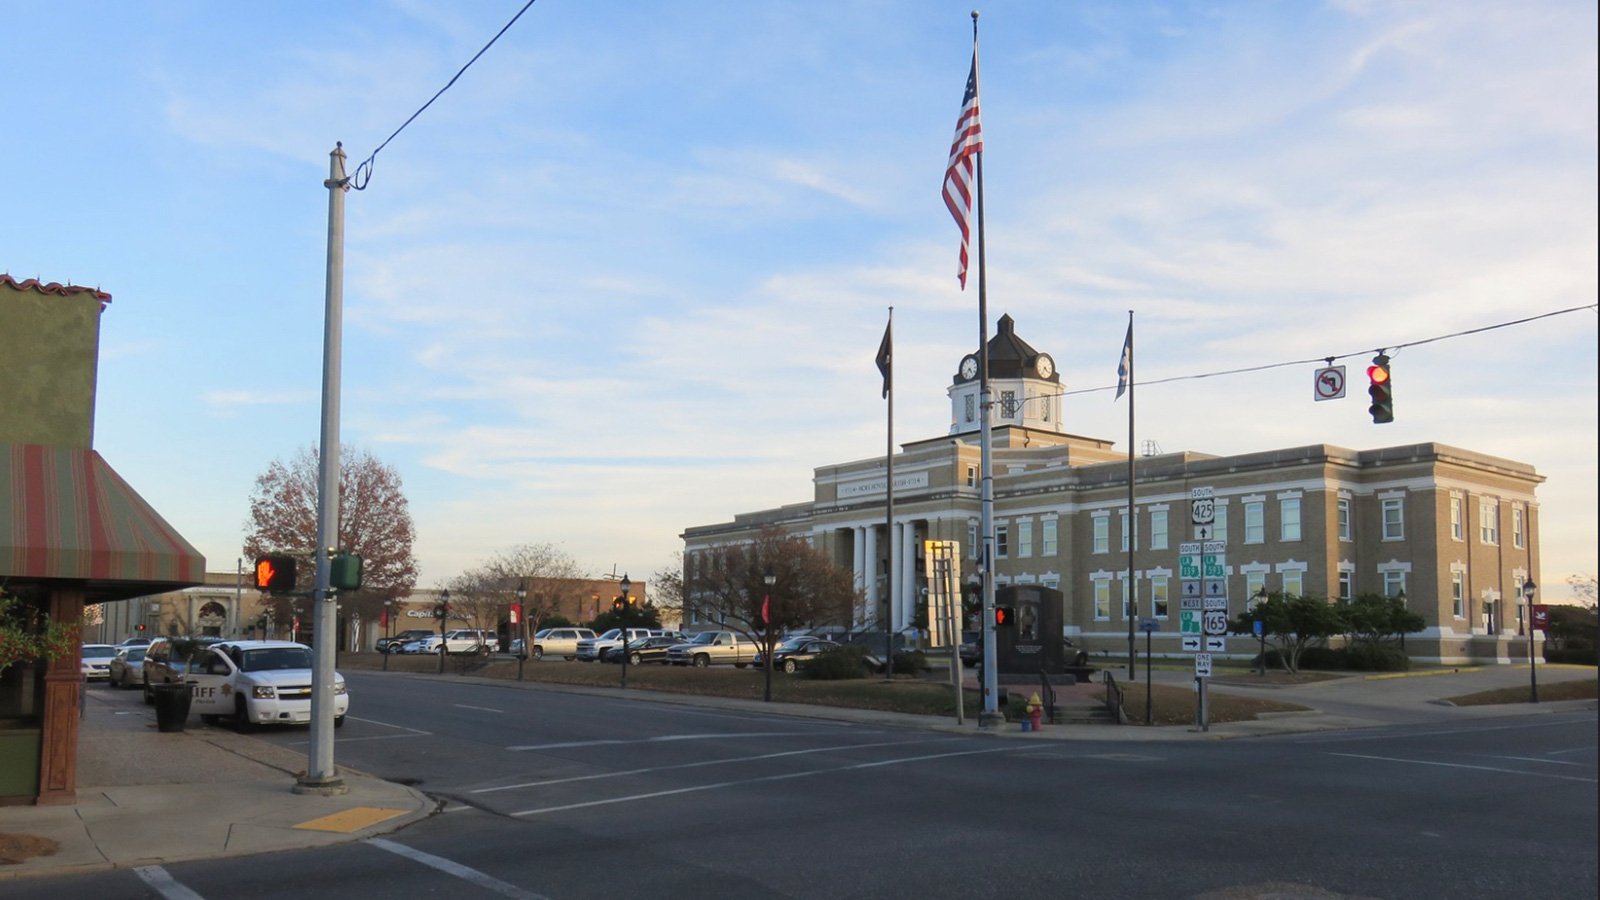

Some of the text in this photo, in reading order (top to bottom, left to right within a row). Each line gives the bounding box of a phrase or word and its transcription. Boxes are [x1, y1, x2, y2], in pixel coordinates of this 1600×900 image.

[1193, 489, 1213, 497] SOUTH
[1194, 504, 1212, 518] 425
[1205, 543, 1224, 551] SOUTH
[1206, 616, 1225, 630] 165
